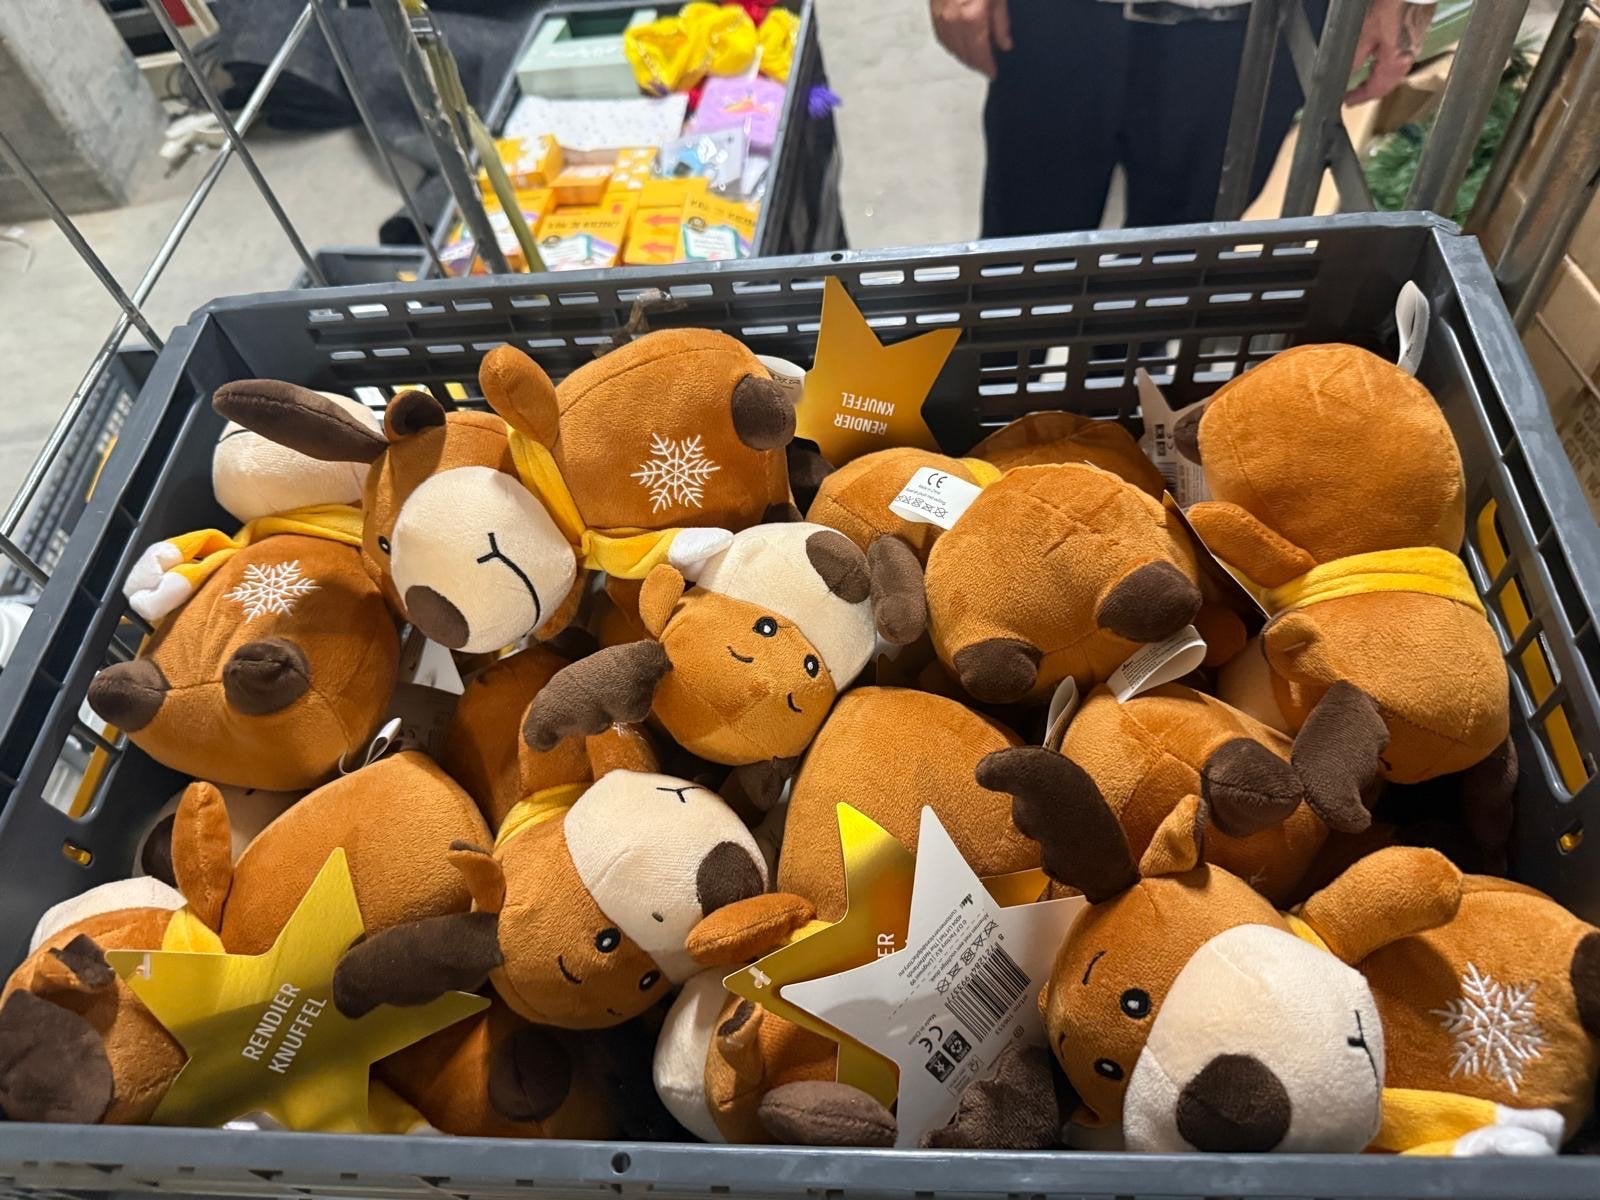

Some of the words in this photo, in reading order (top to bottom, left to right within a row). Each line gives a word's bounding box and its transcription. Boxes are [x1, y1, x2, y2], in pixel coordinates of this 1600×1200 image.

[841, 392, 895, 416] KNUFFEL
[833, 413, 887, 436] RENDIER
[998, 933, 1005, 941] 8
[241, 983, 301, 1060] RENDIER
[268, 998, 327, 1073] KNUFFEL
